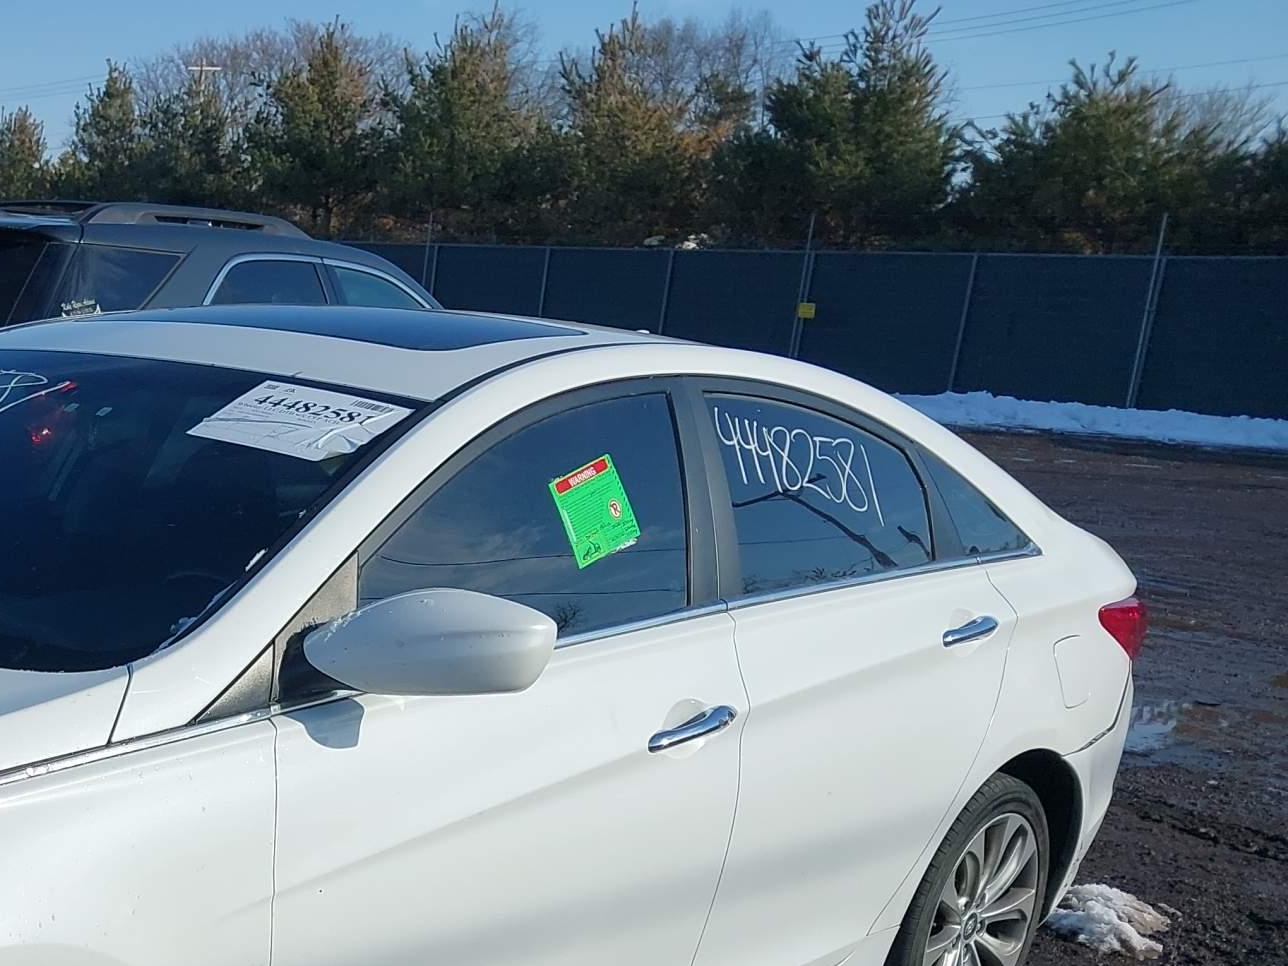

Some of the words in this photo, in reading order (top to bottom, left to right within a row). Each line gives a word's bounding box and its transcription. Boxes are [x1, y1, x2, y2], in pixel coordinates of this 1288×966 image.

[254, 394, 377, 426] 44482581
[567, 466, 597, 487] WARNING
[714, 406, 885, 527] 44482581
